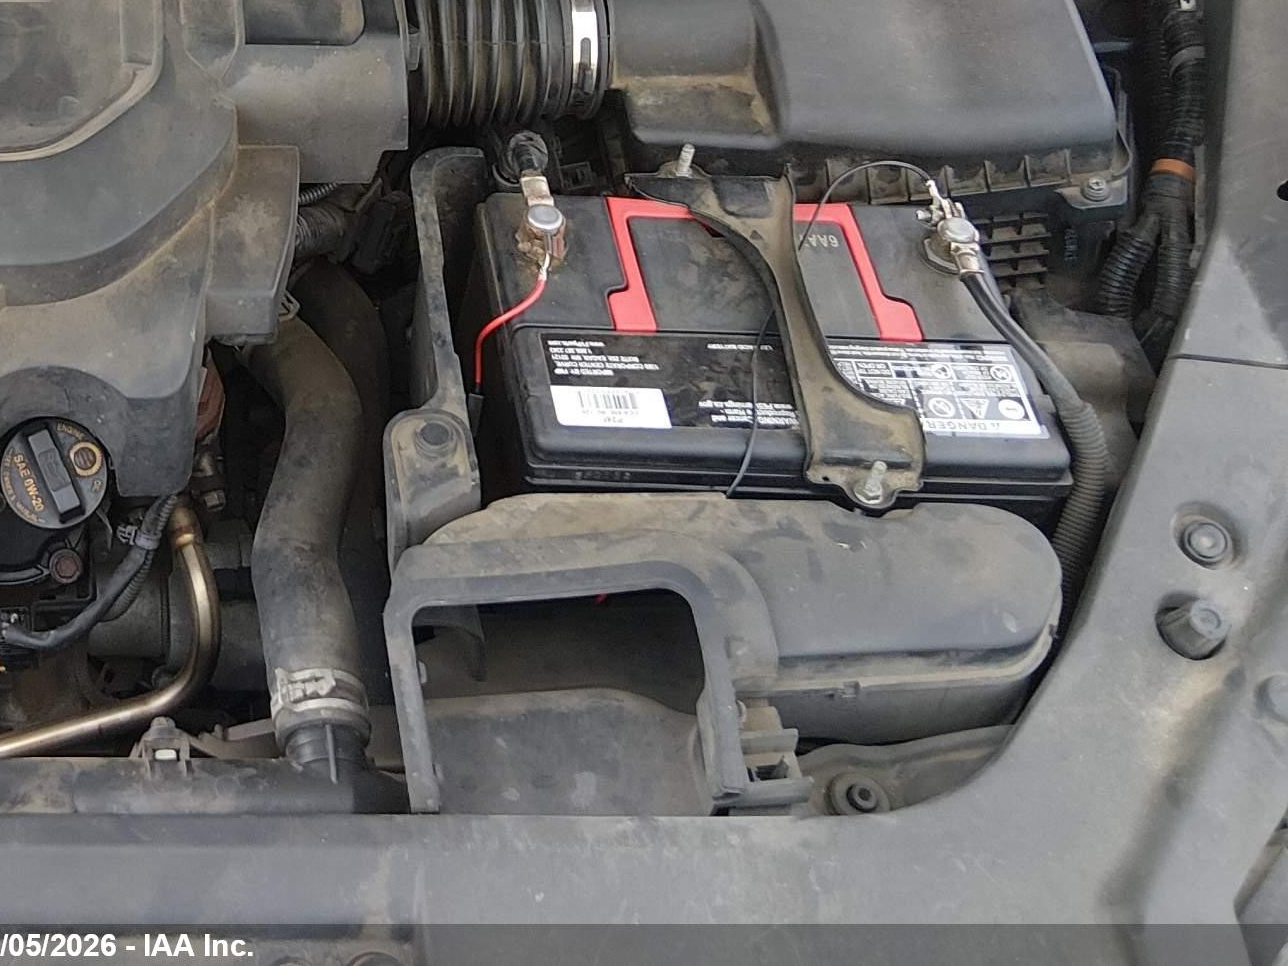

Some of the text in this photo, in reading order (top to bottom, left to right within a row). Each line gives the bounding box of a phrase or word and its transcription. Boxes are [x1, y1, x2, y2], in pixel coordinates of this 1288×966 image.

[56, 422, 86, 440] ENGINE
[927, 419, 991, 431] DANGER
[13, 454, 45, 512] SAE 0W-20
